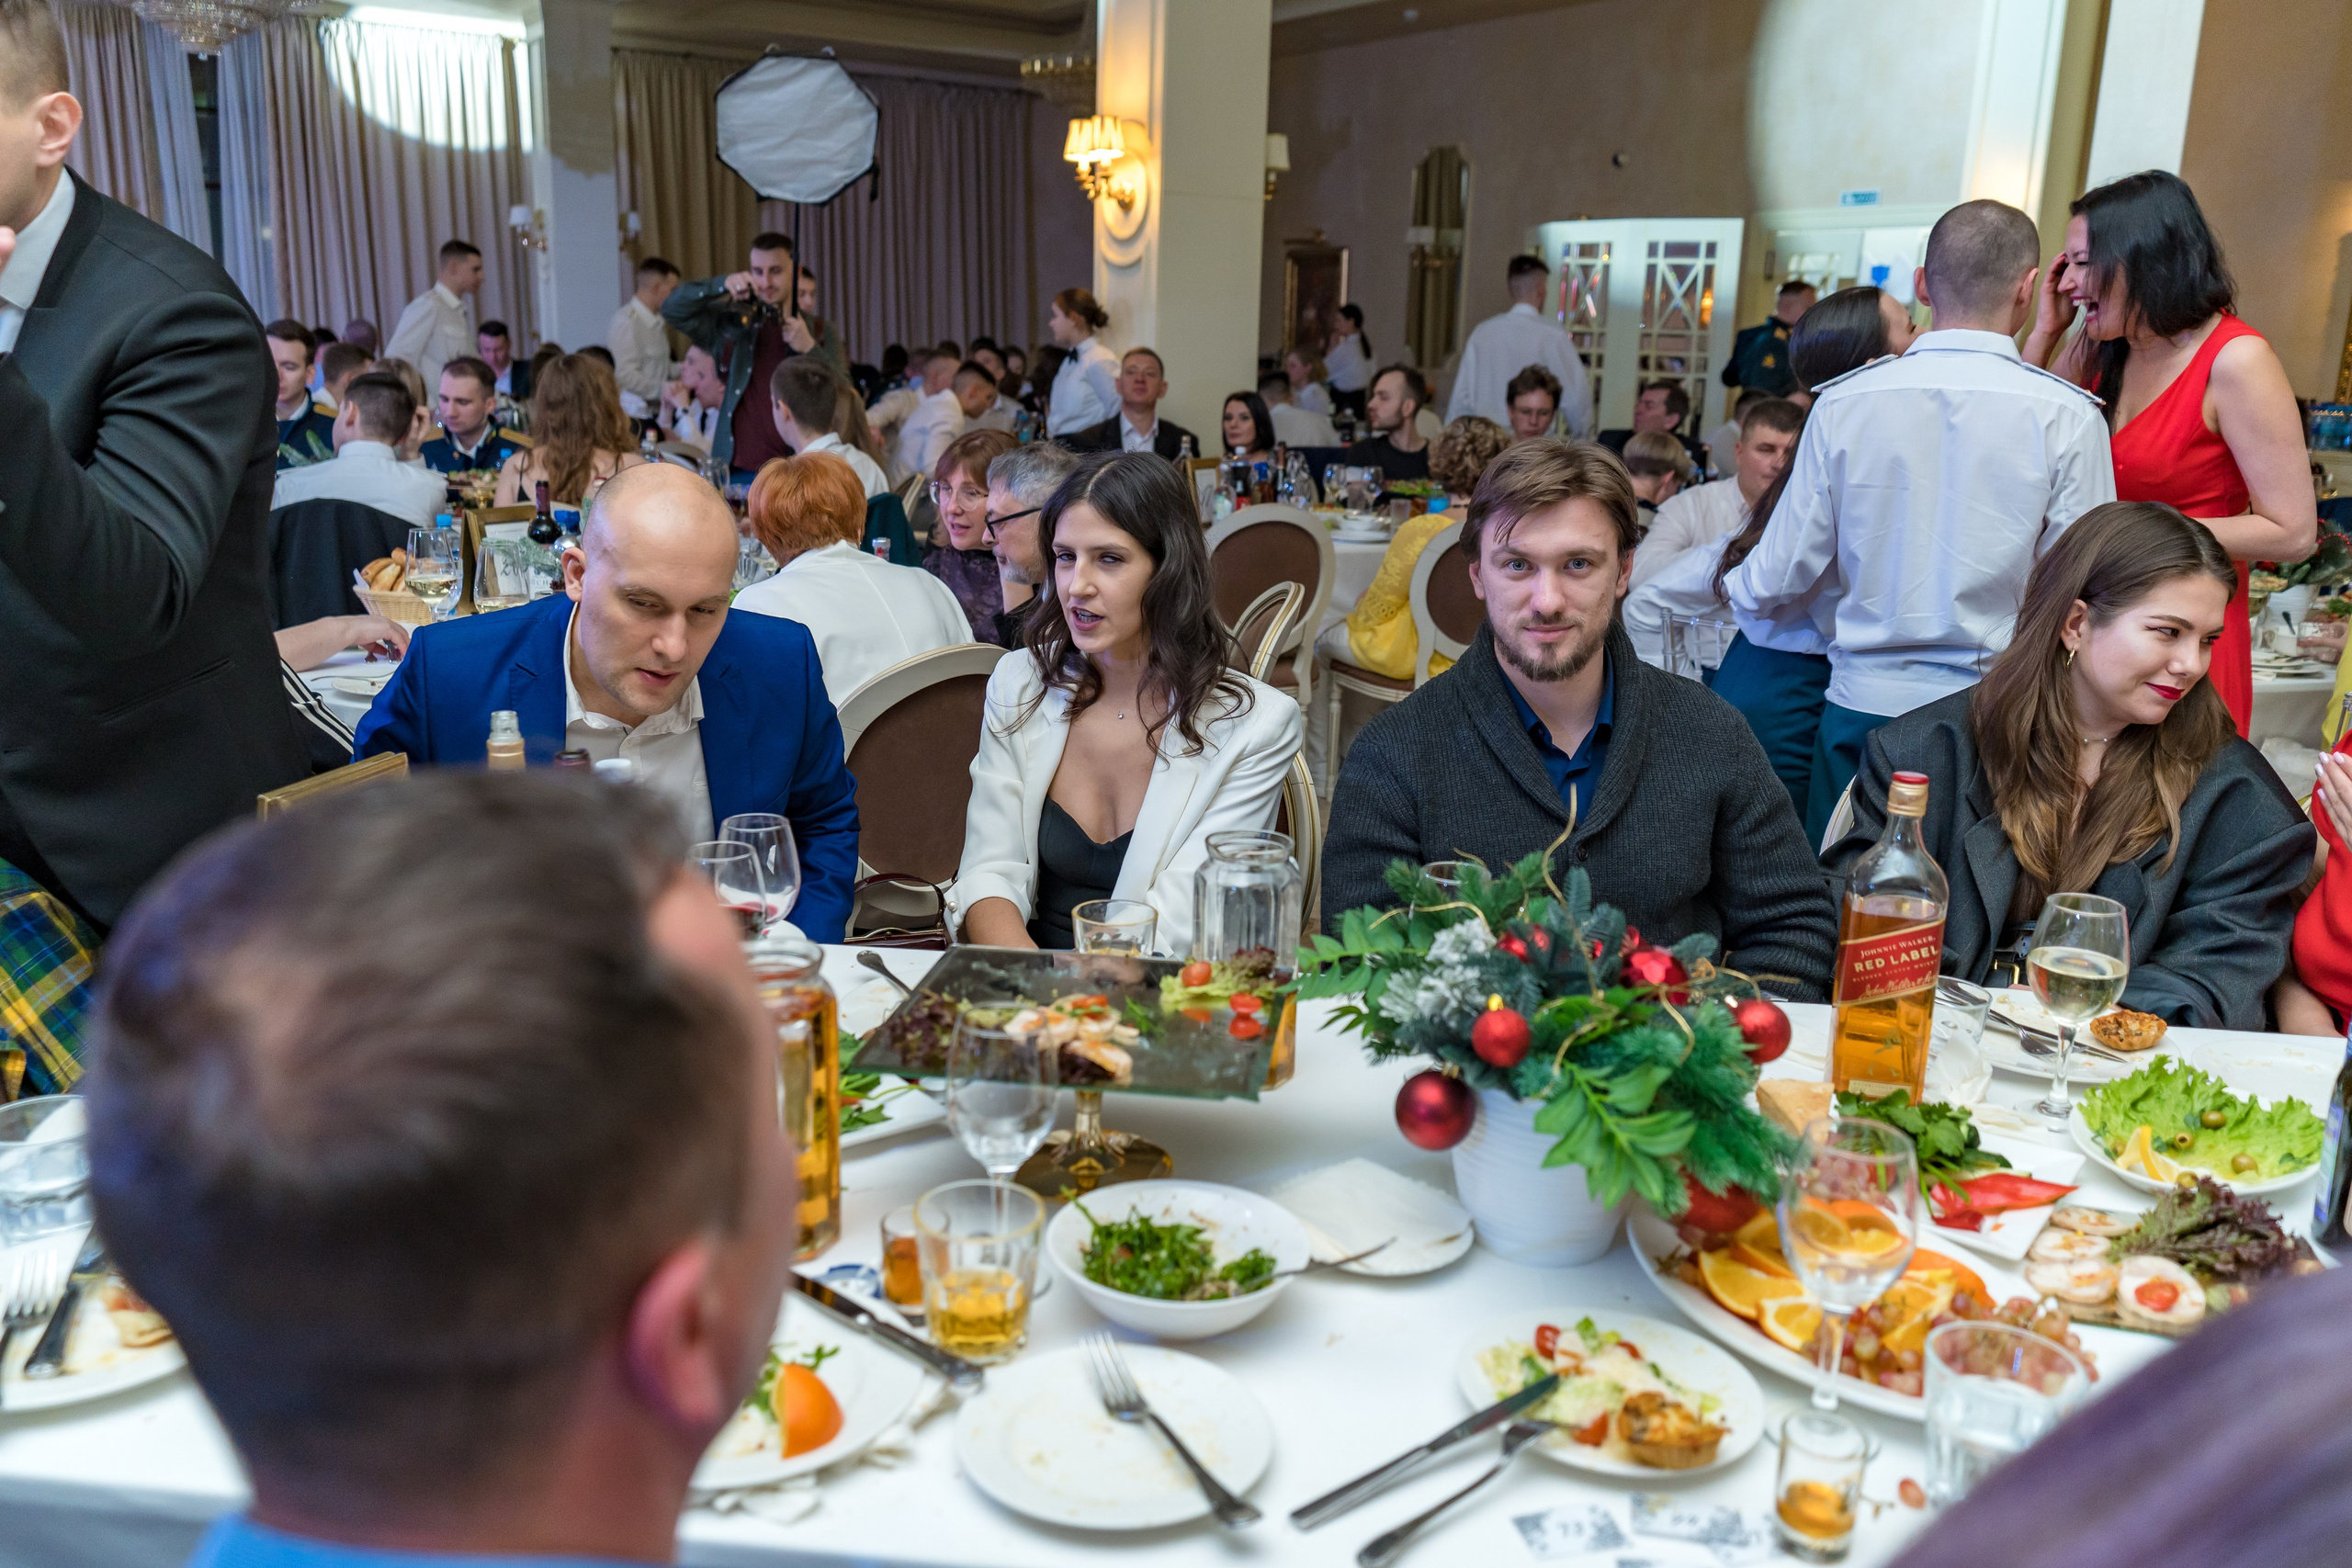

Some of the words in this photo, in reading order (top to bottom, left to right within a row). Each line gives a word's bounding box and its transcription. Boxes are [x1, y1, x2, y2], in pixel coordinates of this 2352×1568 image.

[1854, 957, 1885, 973] RED
[1890, 945, 1939, 965] LABEL
[1860, 943, 1897, 959] JOHNNIE
[1898, 935, 1934, 949] WALKER
